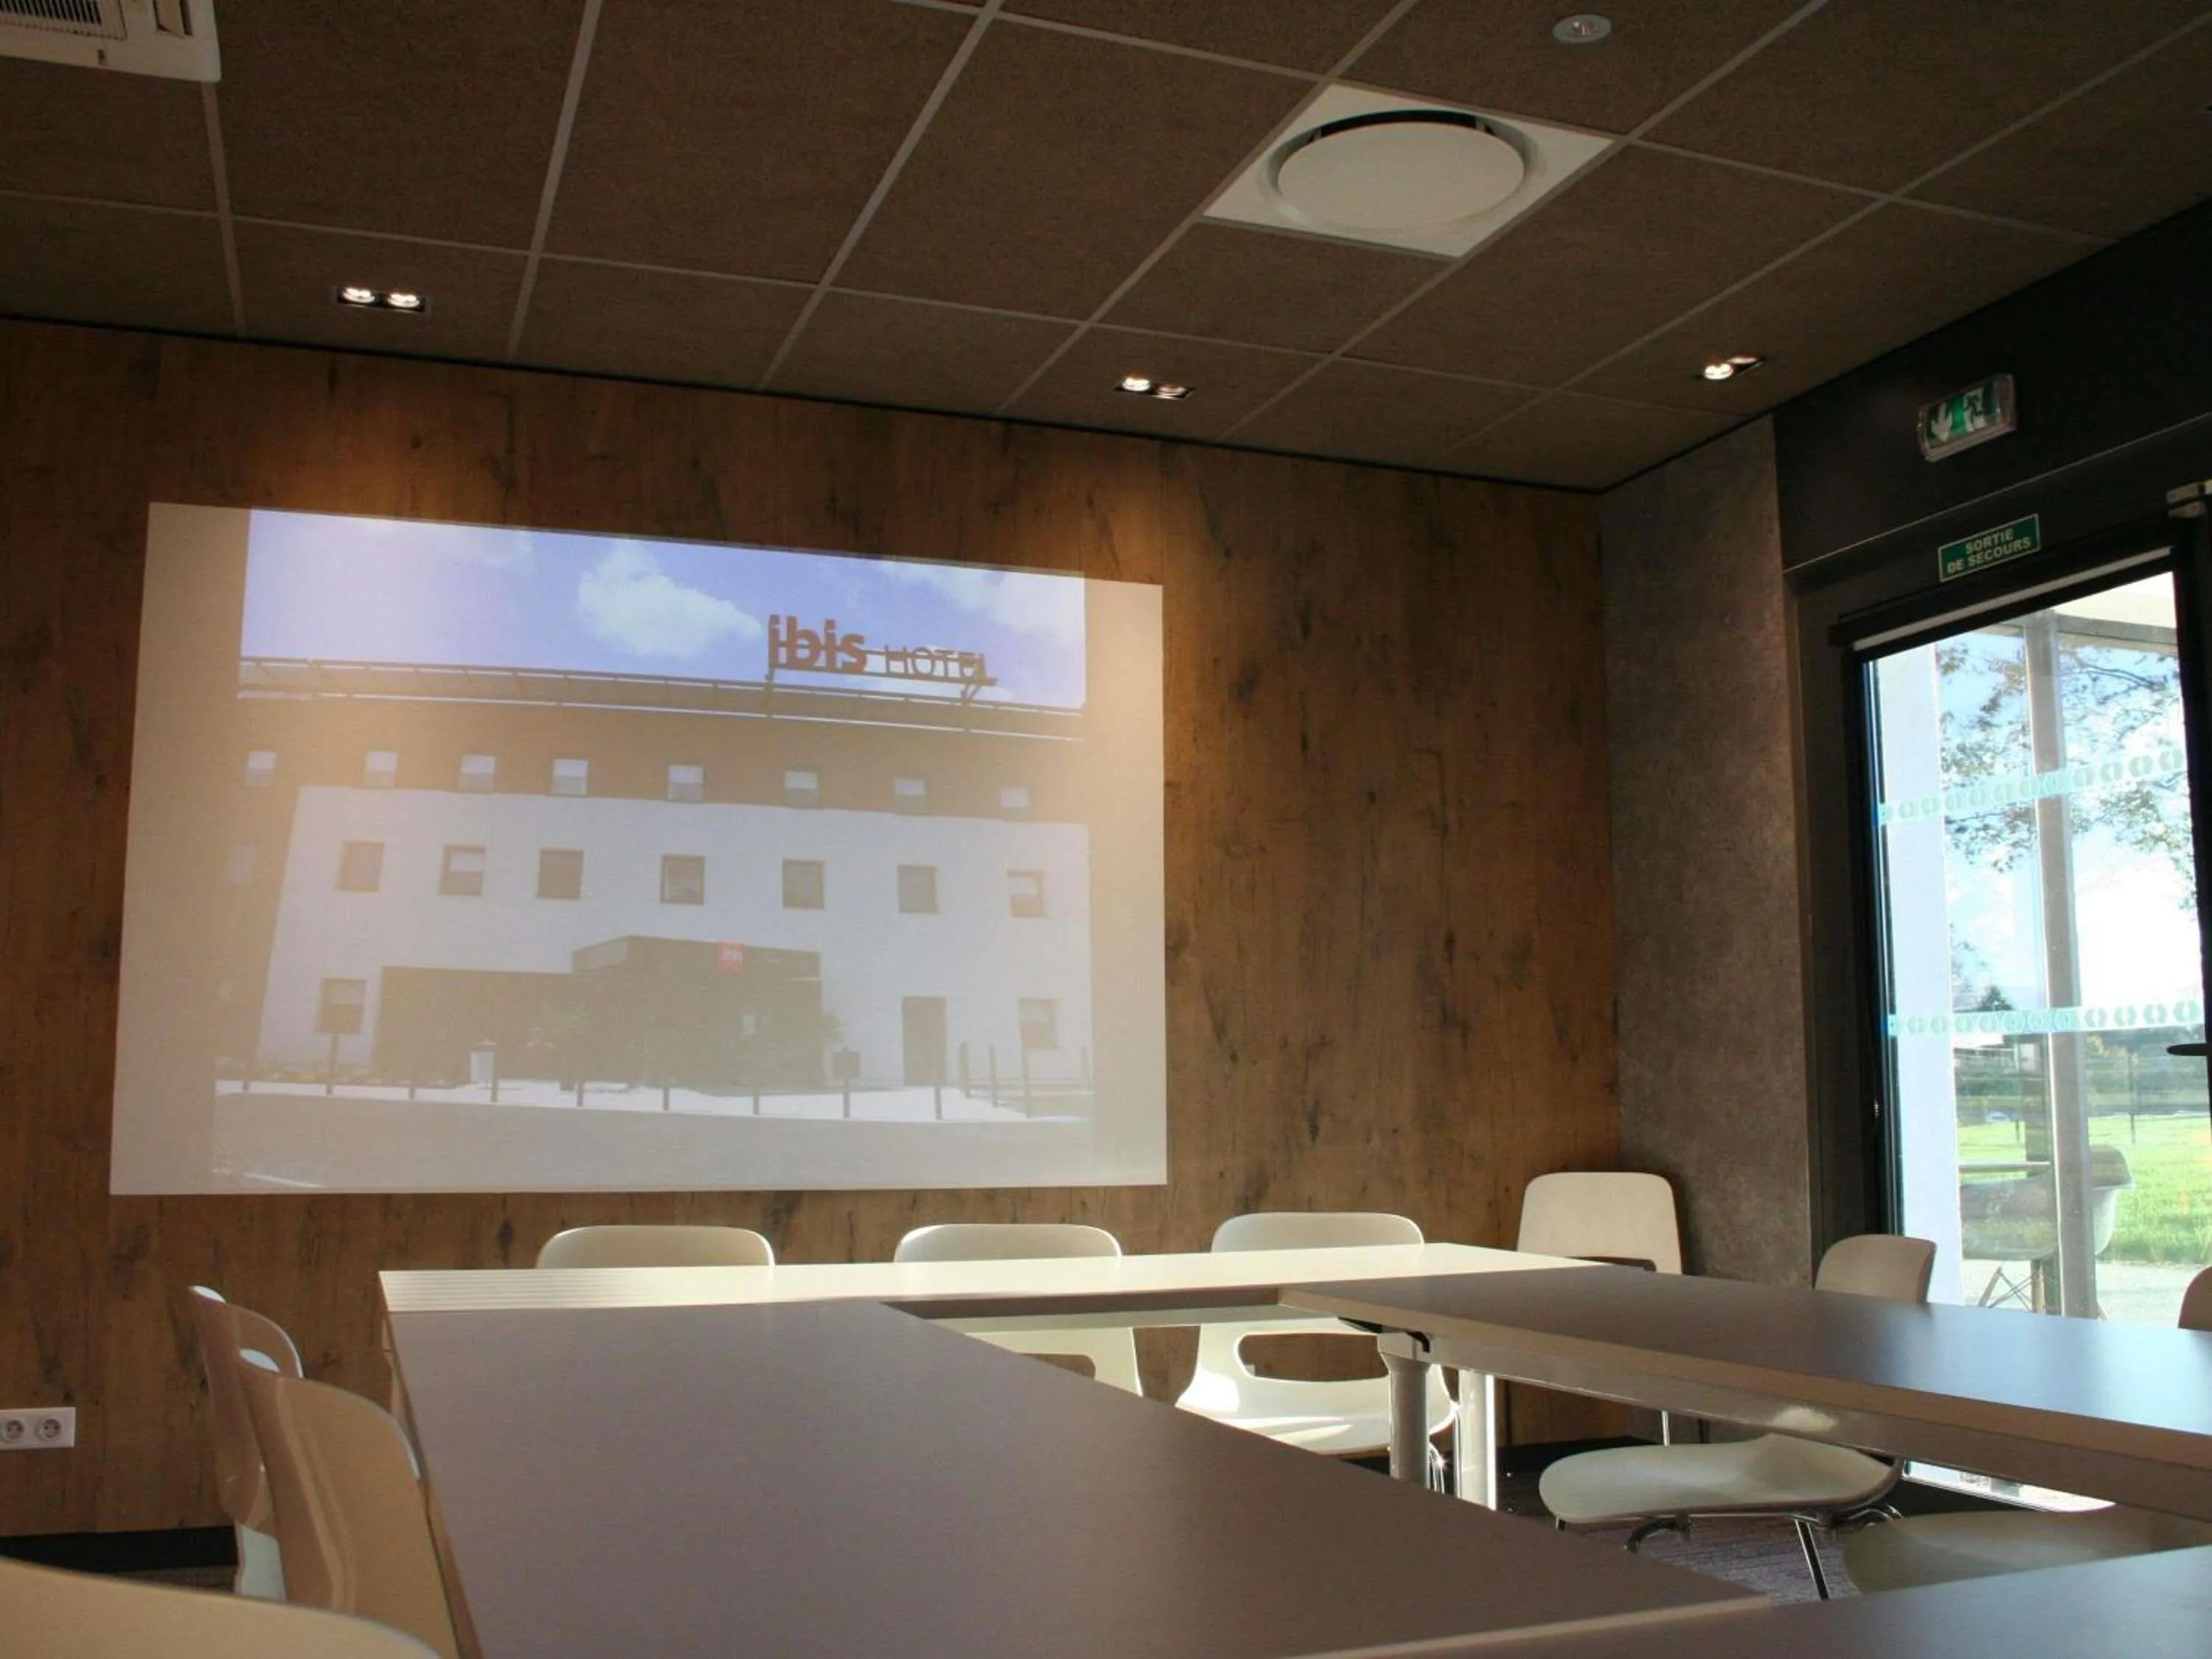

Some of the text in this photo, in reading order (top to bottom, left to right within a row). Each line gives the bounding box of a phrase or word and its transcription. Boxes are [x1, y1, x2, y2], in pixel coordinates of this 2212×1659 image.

[1947, 537, 2031, 573] DE SECOURS
[1966, 529, 2014, 553] SORTIE
[768, 614, 987, 681] ibis HOTEL
